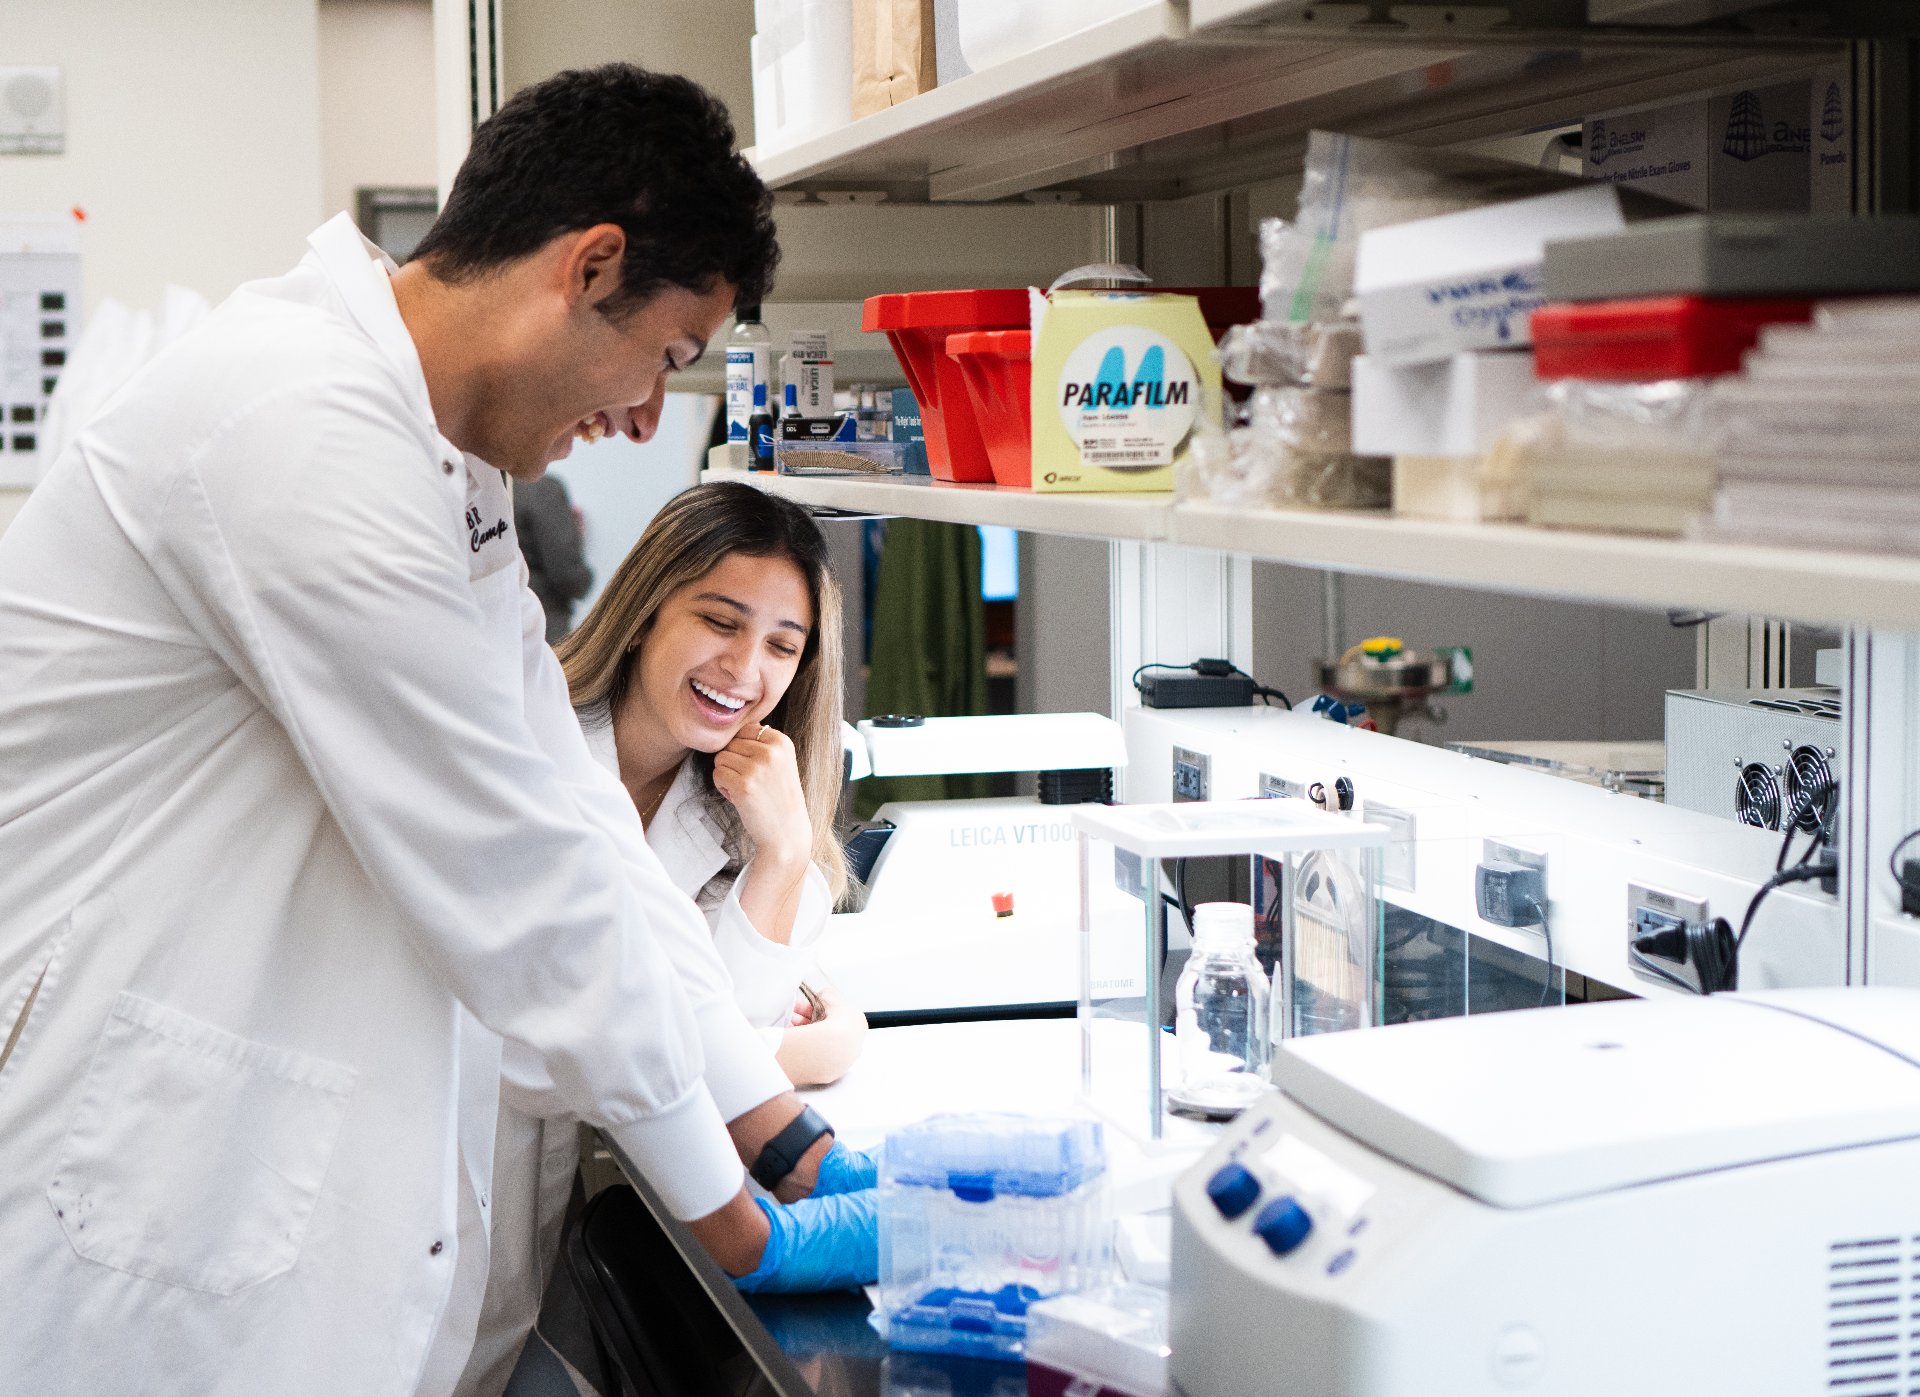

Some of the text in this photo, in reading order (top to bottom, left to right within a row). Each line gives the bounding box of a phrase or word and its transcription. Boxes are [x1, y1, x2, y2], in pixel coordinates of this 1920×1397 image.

[1628, 166, 1648, 179] Nitrile
[1649, 165, 1667, 177] Exam
[1668, 160, 1691, 173] Gloves
[808, 350, 828, 359] LEICA
[811, 368, 819, 391] LEICA
[1064, 382, 1188, 406] PARAFILM
[471, 518, 508, 553] Camp
[950, 825, 1007, 847] LEICA
